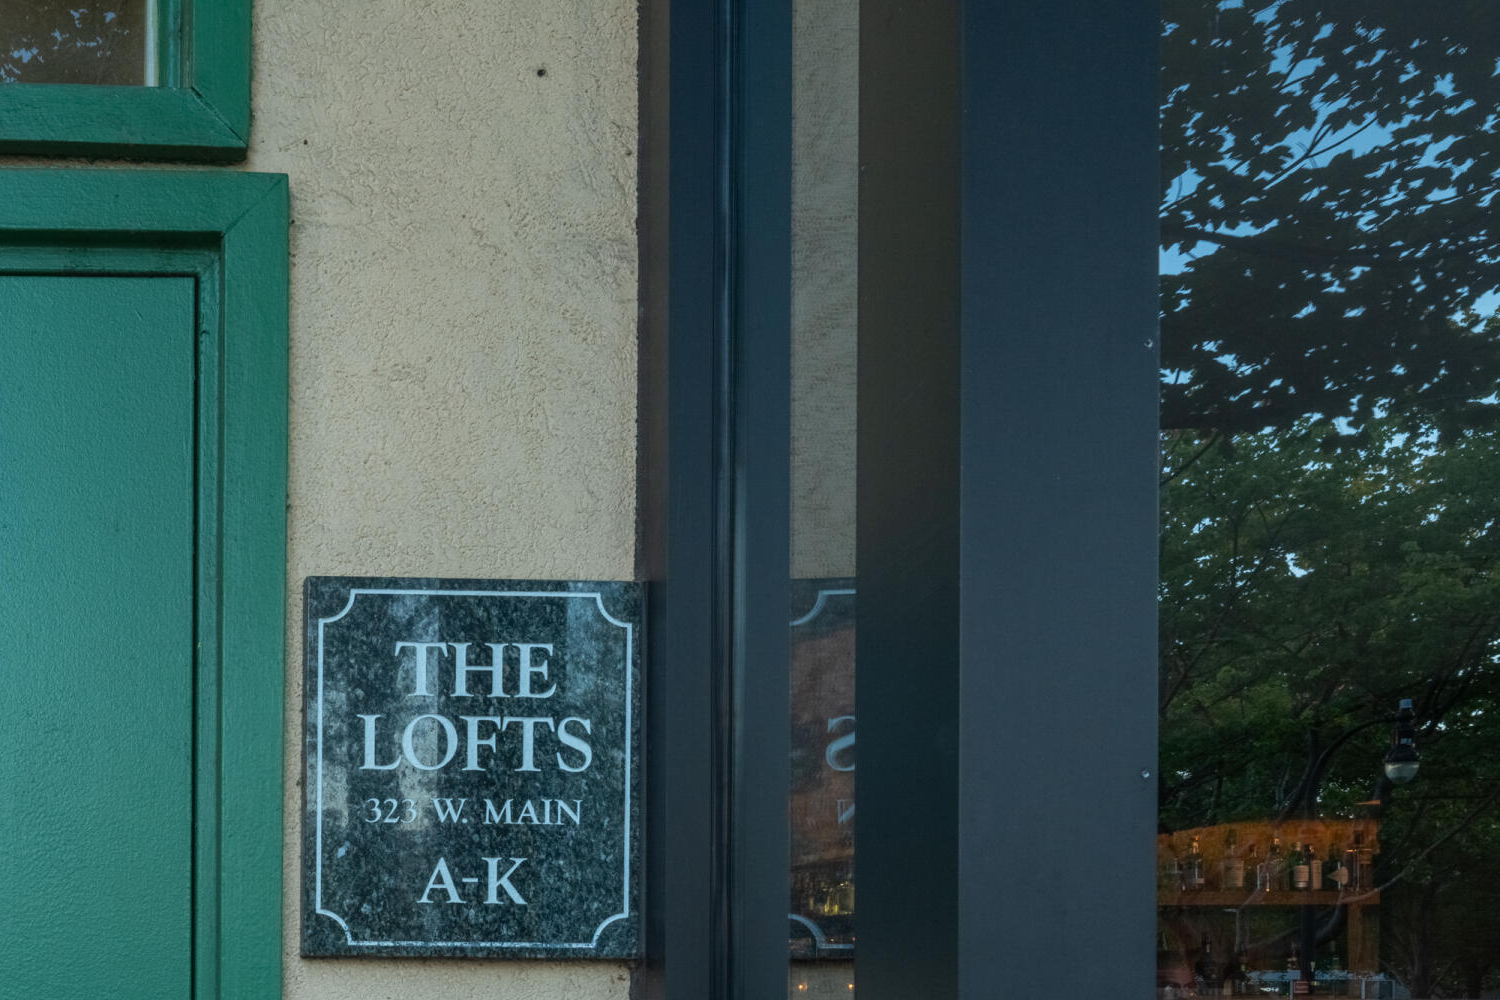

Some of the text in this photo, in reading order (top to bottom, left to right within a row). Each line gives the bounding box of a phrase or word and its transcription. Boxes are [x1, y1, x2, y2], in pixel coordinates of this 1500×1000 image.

[394, 641, 557, 699] THE
[357, 713, 592, 773] LOFTS
[365, 797, 582, 826] 323 W. MAIN
[416, 856, 528, 905] A-K
